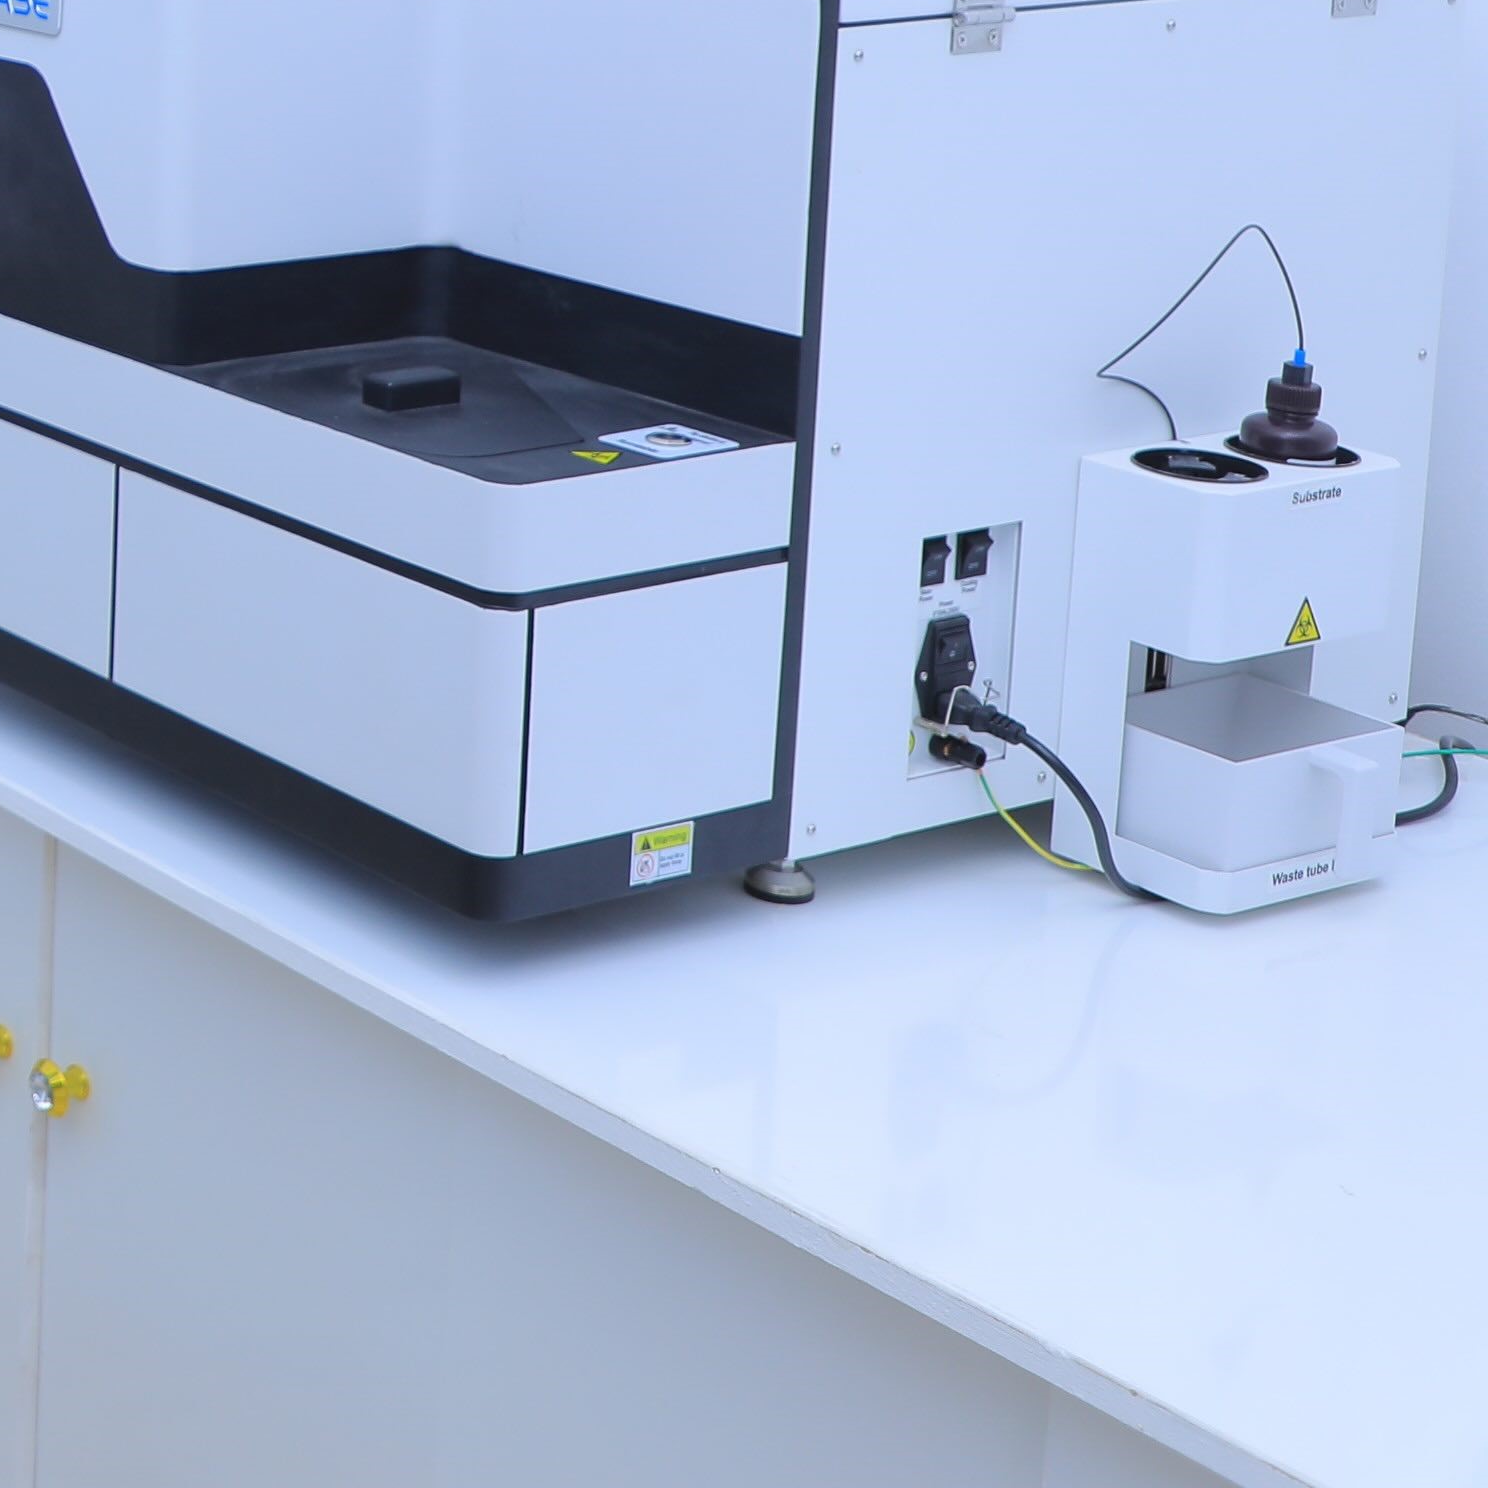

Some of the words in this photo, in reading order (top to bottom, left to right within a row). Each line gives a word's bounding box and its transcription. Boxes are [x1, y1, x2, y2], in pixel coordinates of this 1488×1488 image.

[1292, 486, 1342, 504] Substrate
[1272, 869, 1304, 886] Waste
[1306, 862, 1329, 878] tube
